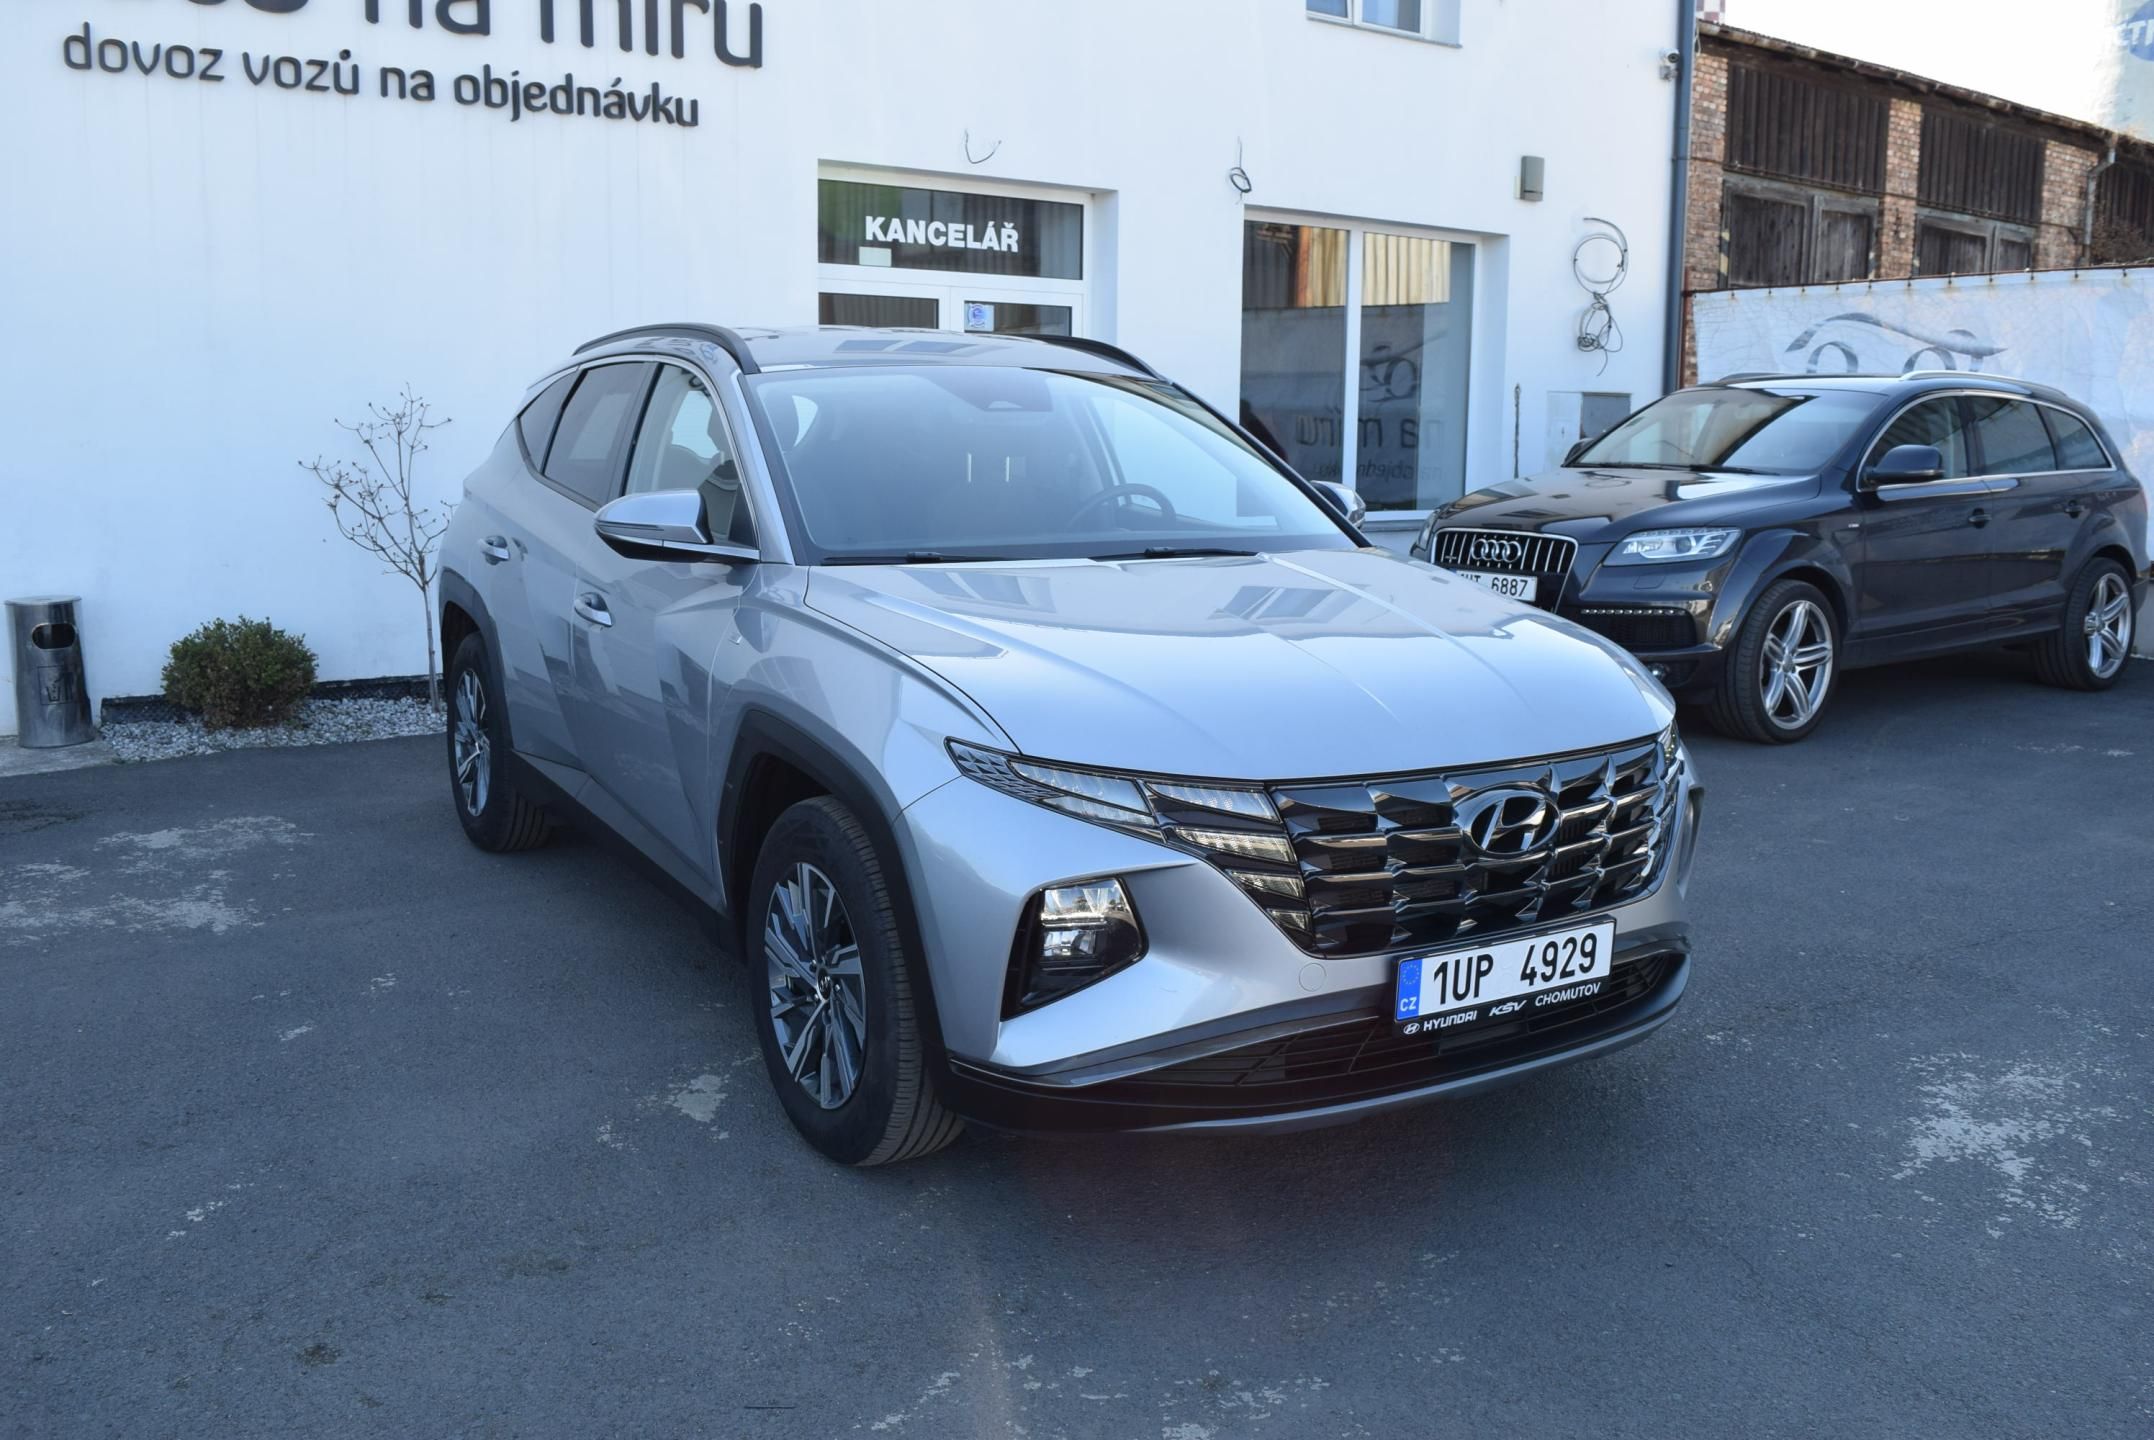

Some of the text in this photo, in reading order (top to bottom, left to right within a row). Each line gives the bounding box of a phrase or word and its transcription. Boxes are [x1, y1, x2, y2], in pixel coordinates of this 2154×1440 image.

[64, 21, 699, 127] dovoz vozů na objednávku
[865, 215, 1019, 253] KANCELÁŘ
[1491, 577, 1528, 597] 6887
[1433, 932, 1598, 1005] 1UP 4929
[1400, 996, 1417, 1011] CZ
[1423, 1010, 1477, 1031] HYUNDAI
[1535, 982, 1601, 1007] CHOMUTOV
